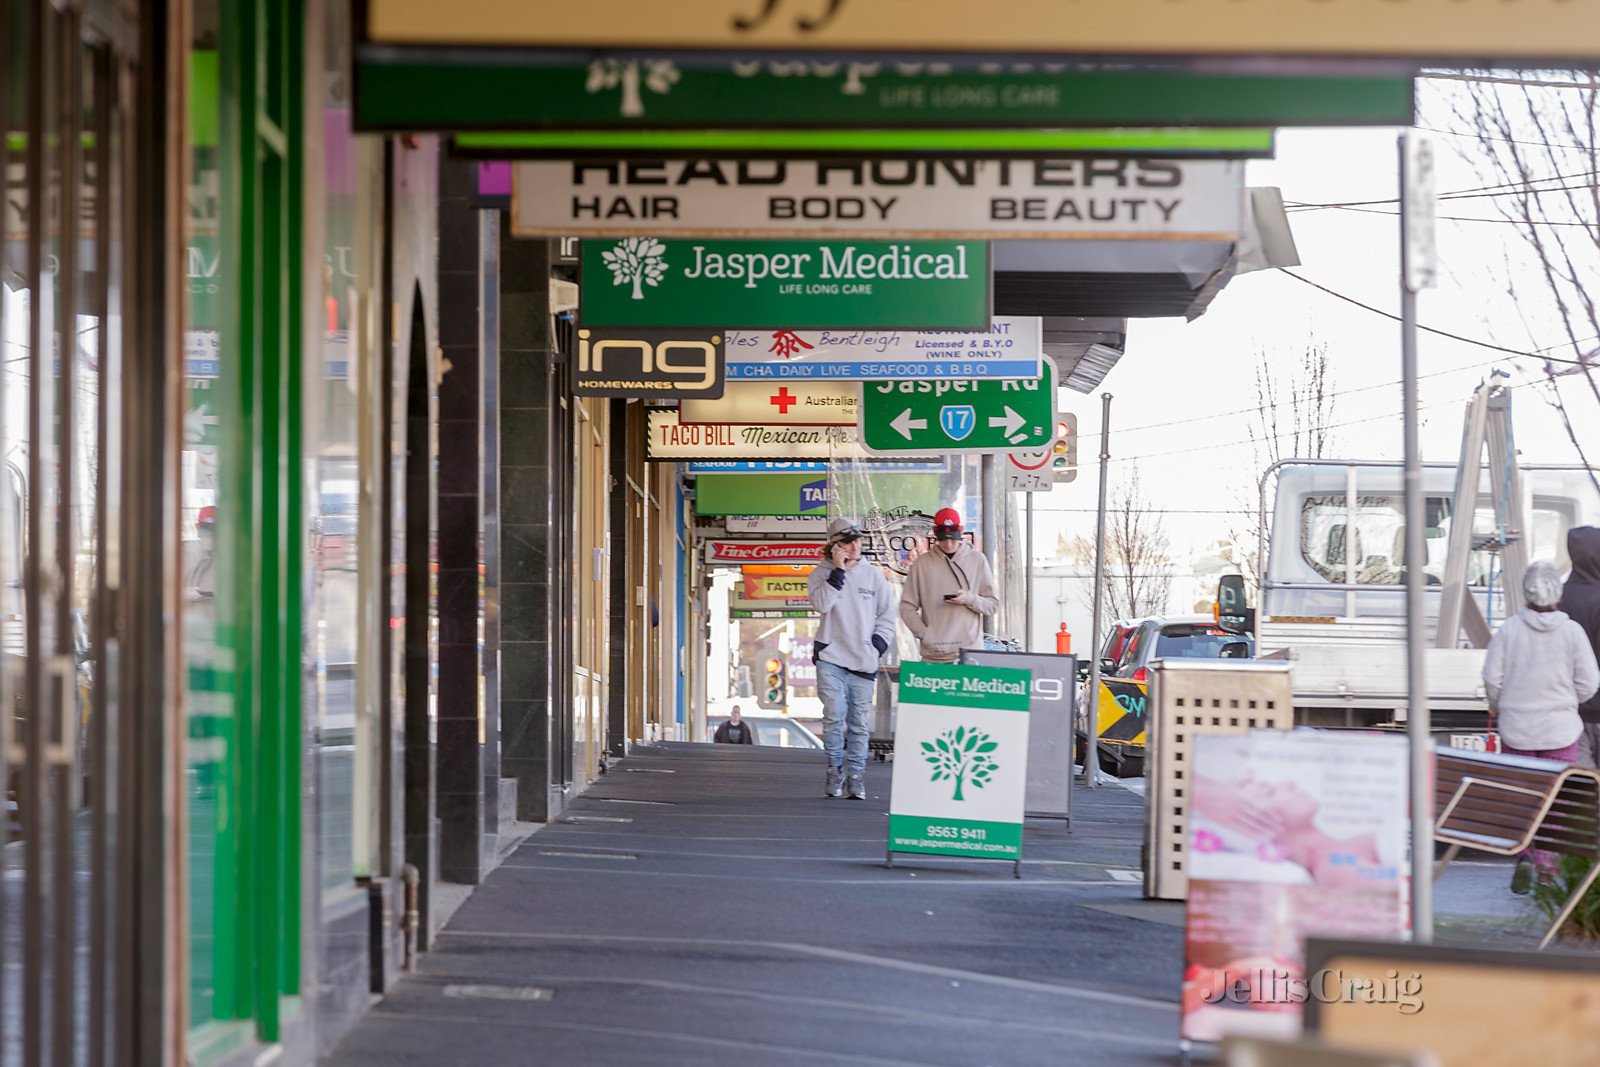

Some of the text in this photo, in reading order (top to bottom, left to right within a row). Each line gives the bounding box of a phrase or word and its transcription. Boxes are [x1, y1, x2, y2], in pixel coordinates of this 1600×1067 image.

[572, 196, 1180, 221] HAIR BODY BEAUTY
[684, 245, 969, 288] Jasper Medical
[779, 284, 873, 295] LIFE LONG CARE
[819, 331, 901, 352] Bentleigh
[915, 339, 1013, 348] Licensed & B.Y.O
[578, 329, 716, 389] ing
[926, 350, 1002, 359] (WINE ONLY)
[743, 365, 773, 376] CHA
[780, 365, 815, 376] DAILY
[821, 365, 850, 376] LIVE
[860, 364, 928, 376] SEAFOOD
[934, 365, 944, 375] &
[950, 364, 988, 375] B.B.Q
[578, 381, 673, 389] HOMEWARES
[946, 410, 970, 429] 17
[660, 425, 700, 445] TACO
[705, 425, 735, 445] BILL
[741, 427, 821, 447] Mexican
[719, 544, 822, 558] Fine Gourmet
[905, 673, 1026, 695] Jasper Medical
[927, 825, 986, 840] 9563 9411
[895, 838, 1017, 853] www.jaspermedical.com.au
